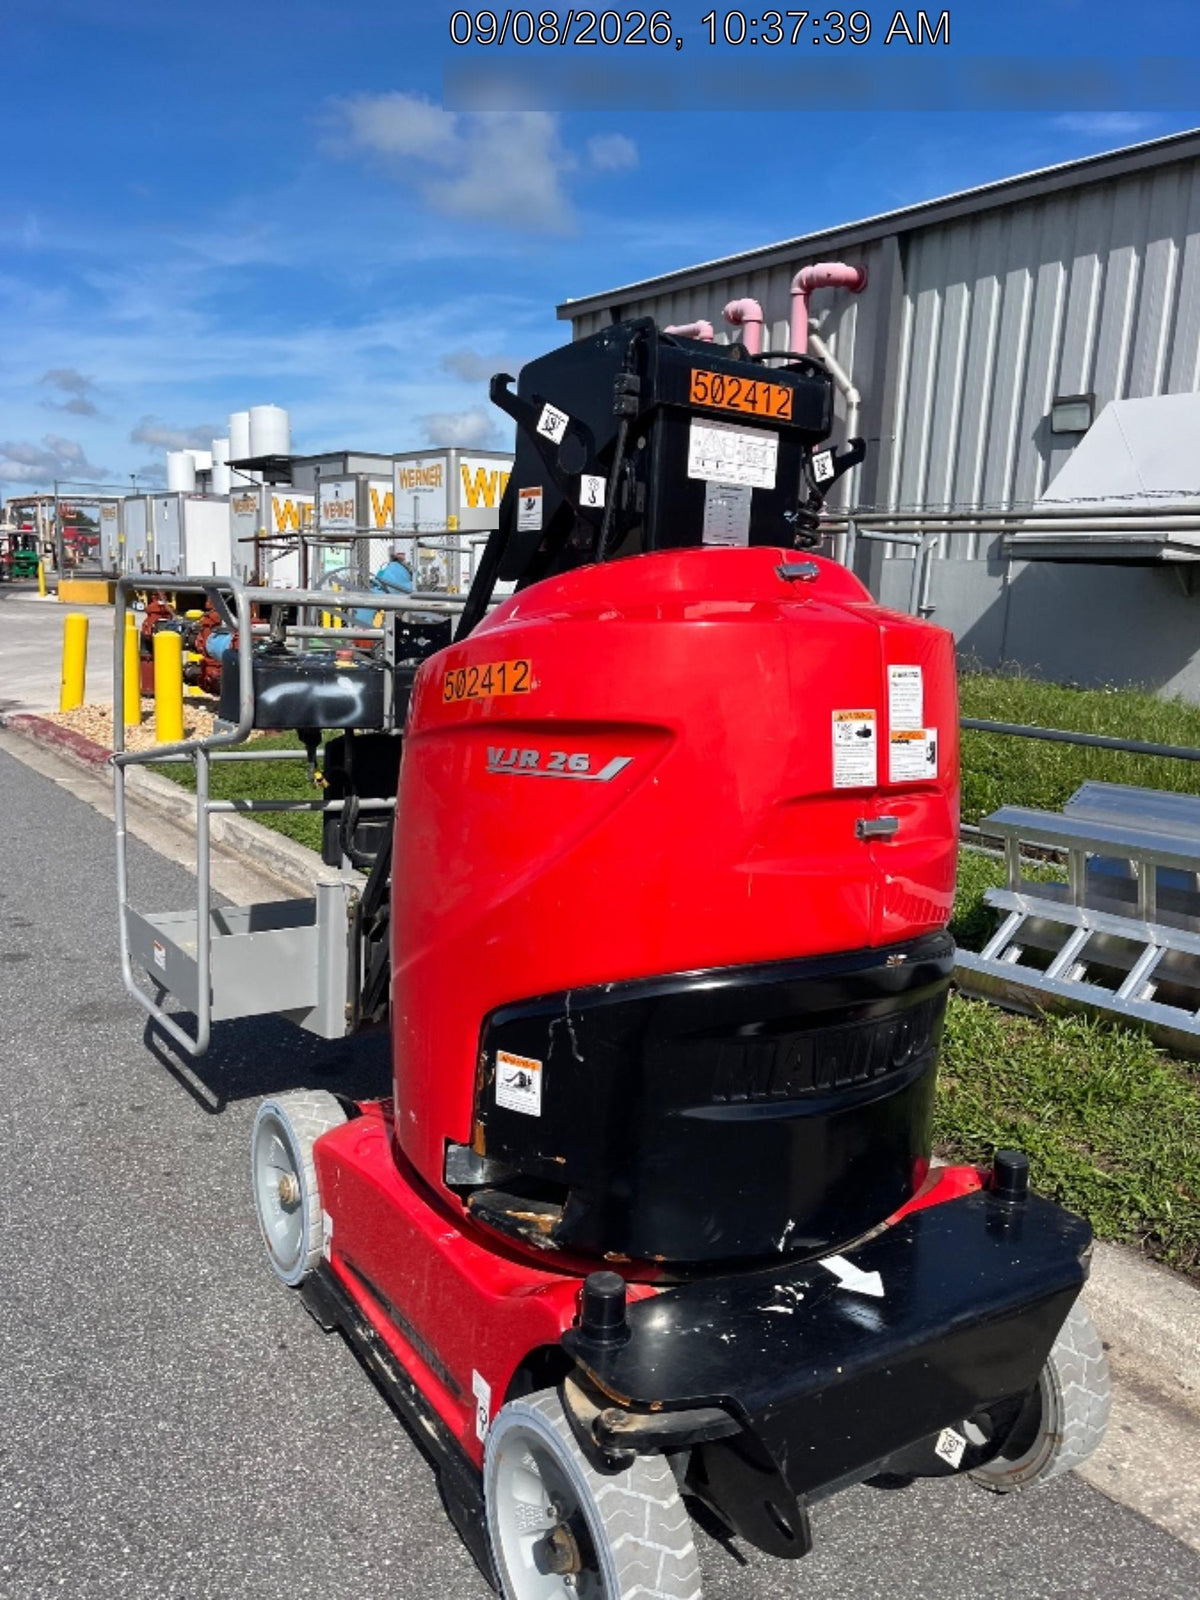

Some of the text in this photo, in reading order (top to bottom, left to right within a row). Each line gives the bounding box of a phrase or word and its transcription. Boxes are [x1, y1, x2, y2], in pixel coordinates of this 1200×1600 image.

[693, 371, 791, 416] 502412
[399, 464, 442, 489] WERNER
[443, 660, 530, 701] 502412
[487, 746, 590, 772] VJR 26
